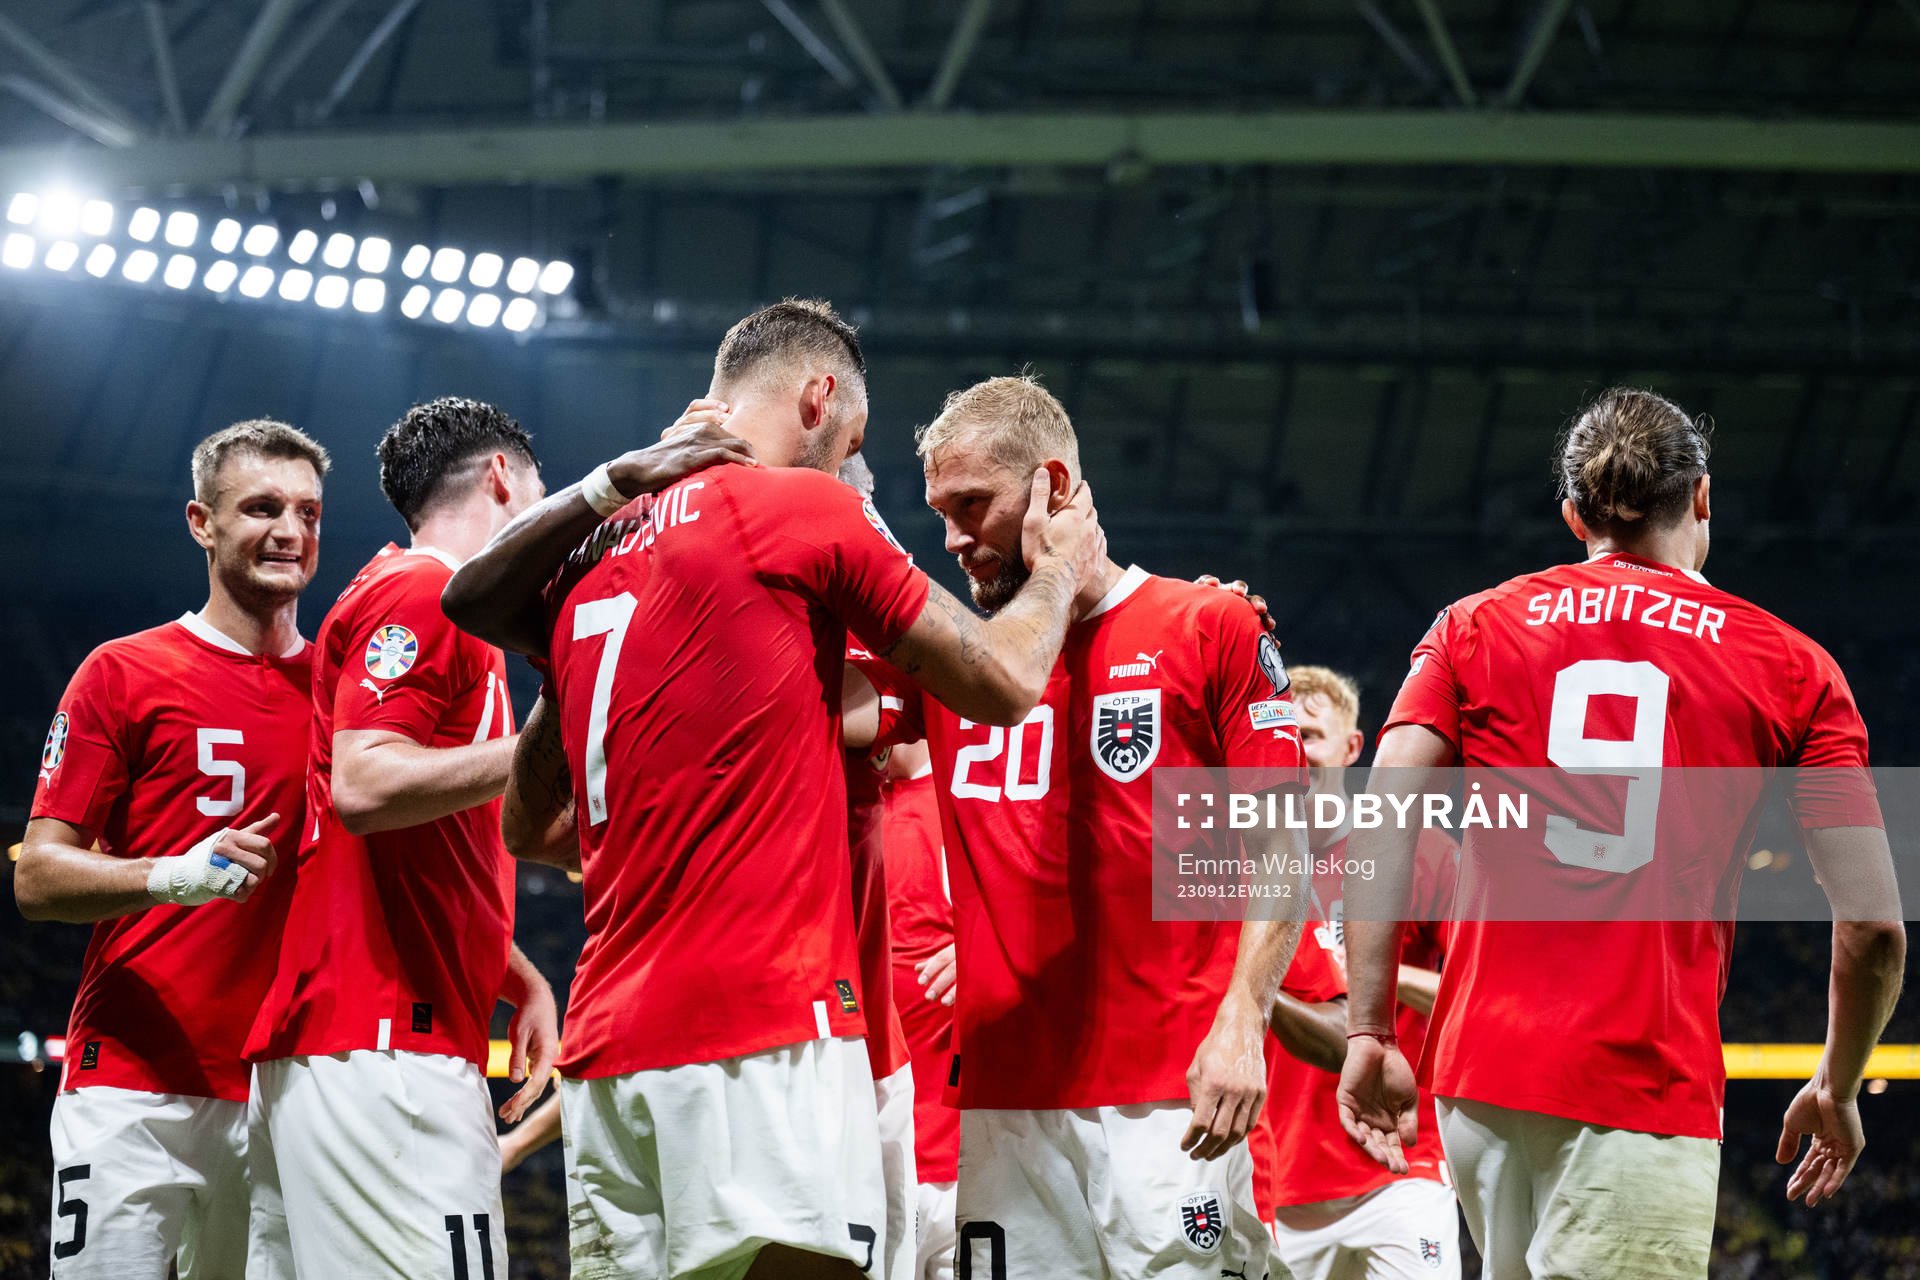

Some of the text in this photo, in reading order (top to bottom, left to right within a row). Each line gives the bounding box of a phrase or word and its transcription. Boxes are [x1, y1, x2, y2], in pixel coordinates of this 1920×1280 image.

[1526, 585, 1726, 643] SABITZER
[573, 591, 638, 827] 7
[1109, 663, 1150, 679] PUMA
[197, 728, 245, 816] 5
[951, 704, 1053, 802] 20
[1544, 660, 1669, 873] 9
[54, 1164, 91, 1260] 5
[445, 1213, 494, 1280] 11
